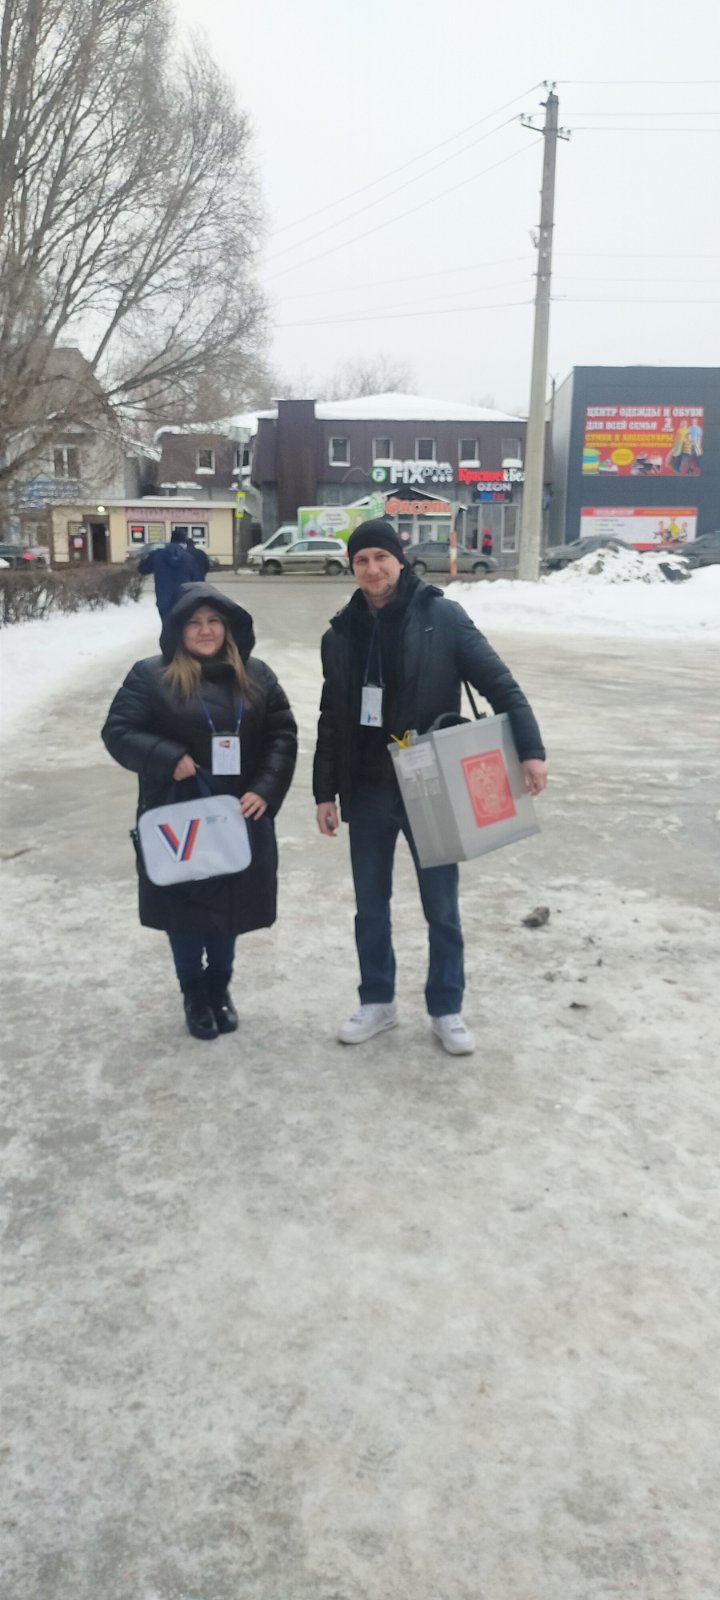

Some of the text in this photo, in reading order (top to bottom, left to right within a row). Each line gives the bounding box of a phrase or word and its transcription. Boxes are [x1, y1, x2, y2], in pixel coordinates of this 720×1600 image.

[587, 407, 704, 418] ЦЕНТР ОДЕЖДЫ И ОБУВИ
[586, 419, 658, 432] ДЛЯ ВСЕЙ СЕМЬИ
[390, 465, 425, 484] FIX
[477, 483, 512, 492] OZON
